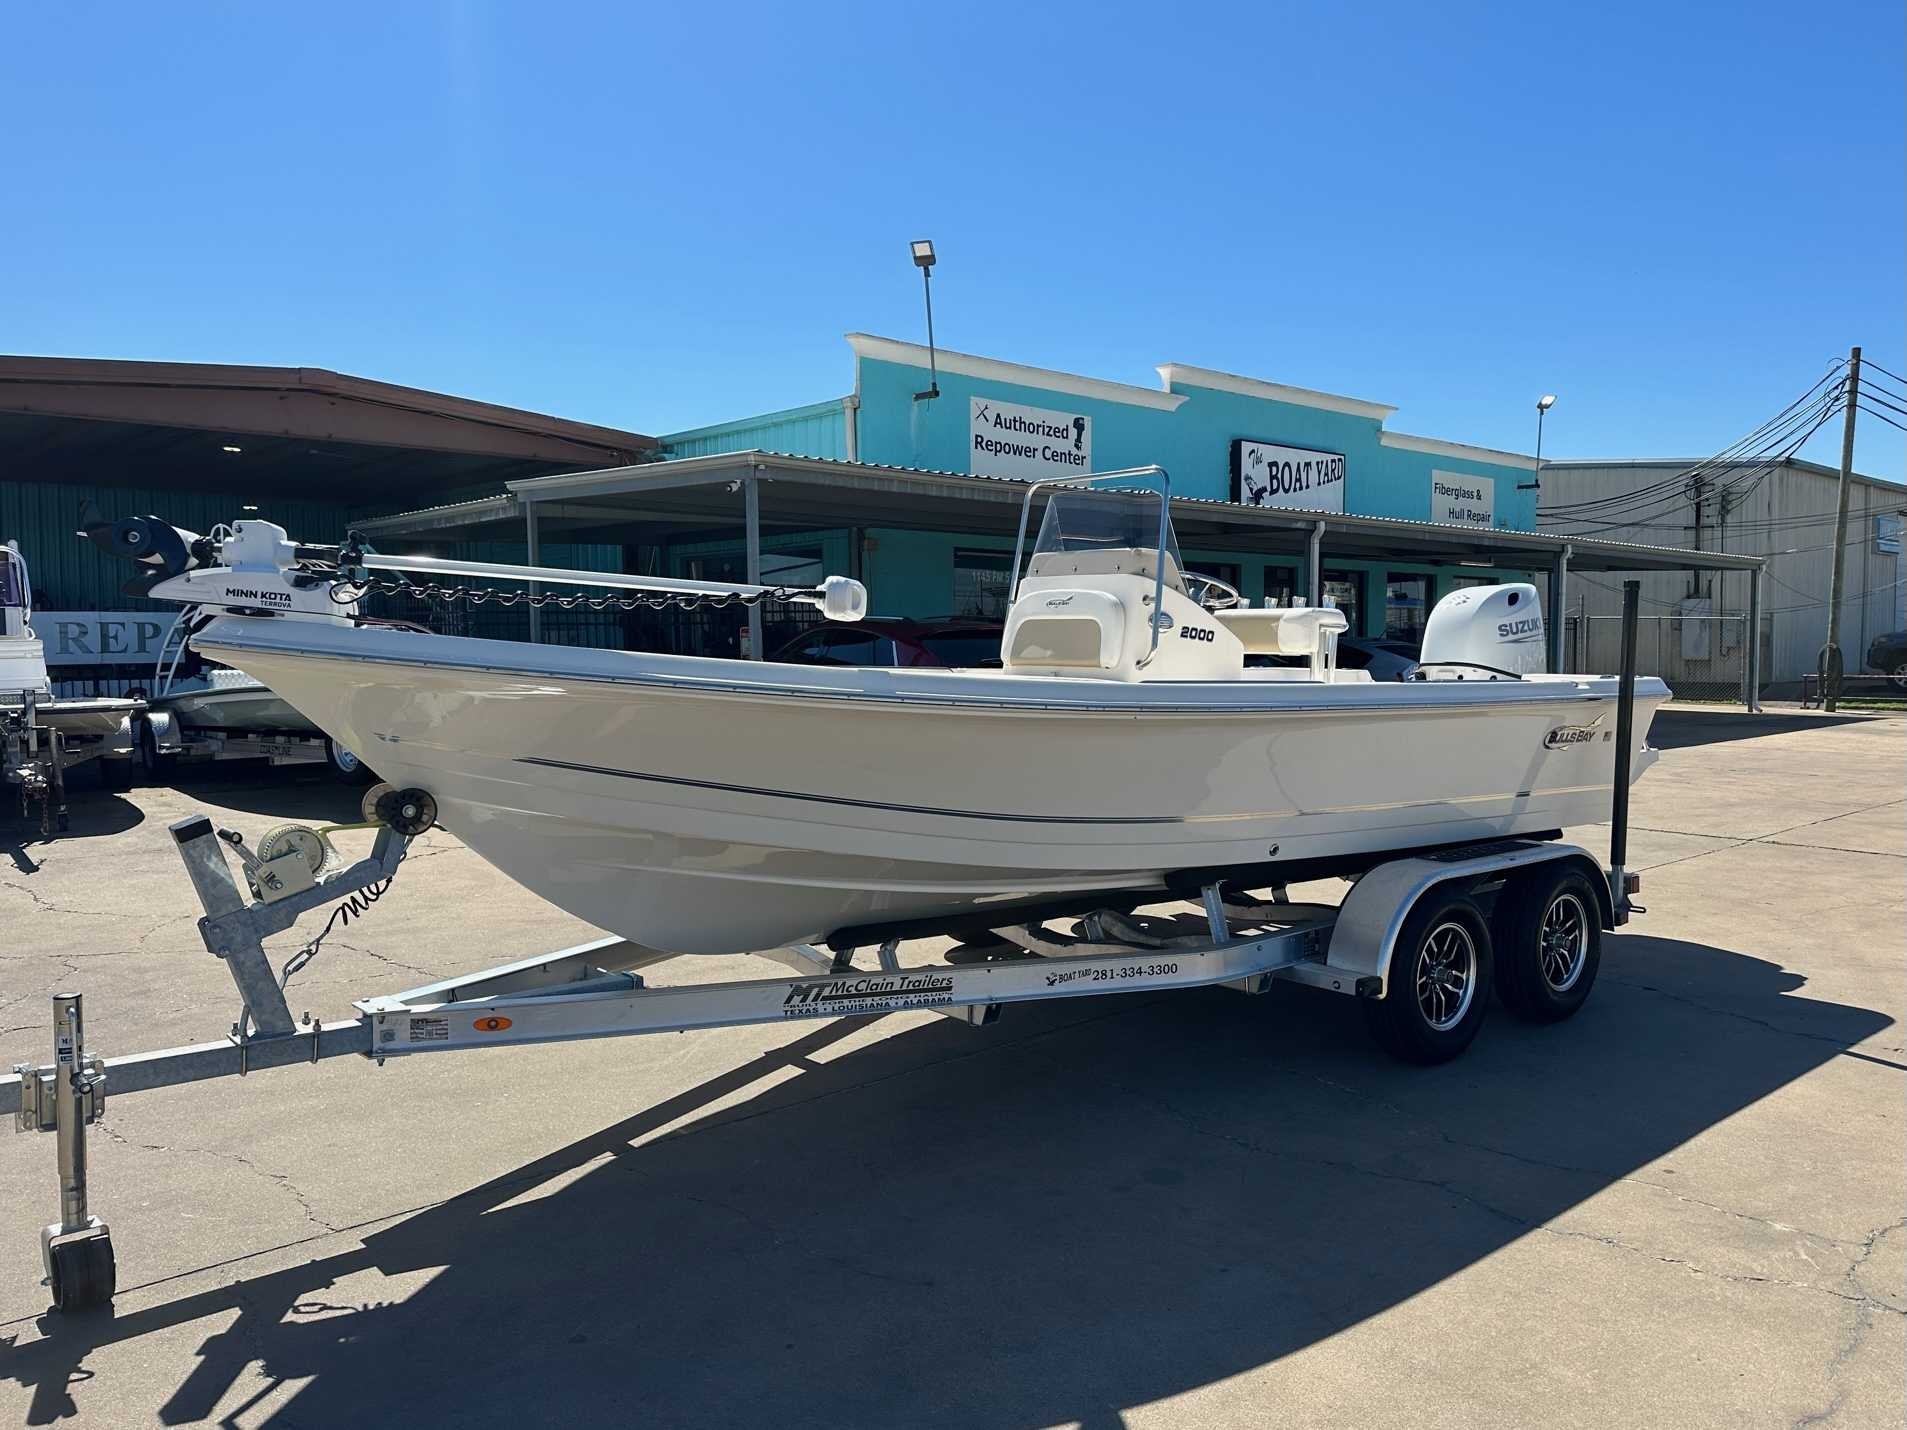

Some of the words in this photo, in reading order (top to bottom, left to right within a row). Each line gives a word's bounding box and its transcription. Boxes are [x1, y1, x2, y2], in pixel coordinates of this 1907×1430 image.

[993, 412, 1069, 440] Authorized
[974, 433, 1038, 459] Repower
[1042, 445, 1086, 466] Center
[1248, 447, 1263, 469] The
[1267, 460, 1312, 496] BOAT
[1315, 457, 1344, 487] YARD
[1434, 482, 1475, 500] Fiberglass
[1475, 489, 1482, 501] &
[1448, 507, 1465, 520] Hull
[1466, 509, 1491, 524] Repair
[225, 587, 258, 599] MINN
[259, 591, 292, 602] KOTA
[260, 600, 292, 609] TERROVA
[1180, 626, 1215, 643] 2000
[1058, 971, 1077, 984] BOAT
[1077, 968, 1092, 979] YARD
[1092, 963, 1178, 981] 281-334-3300
[829, 978, 894, 994] McClain
[899, 975, 953, 990] Trailers
[783, 1007, 819, 1017] TEXAS
[831, 1001, 890, 1012] LOUISIANA
[902, 995, 953, 1007] ALABAMA
